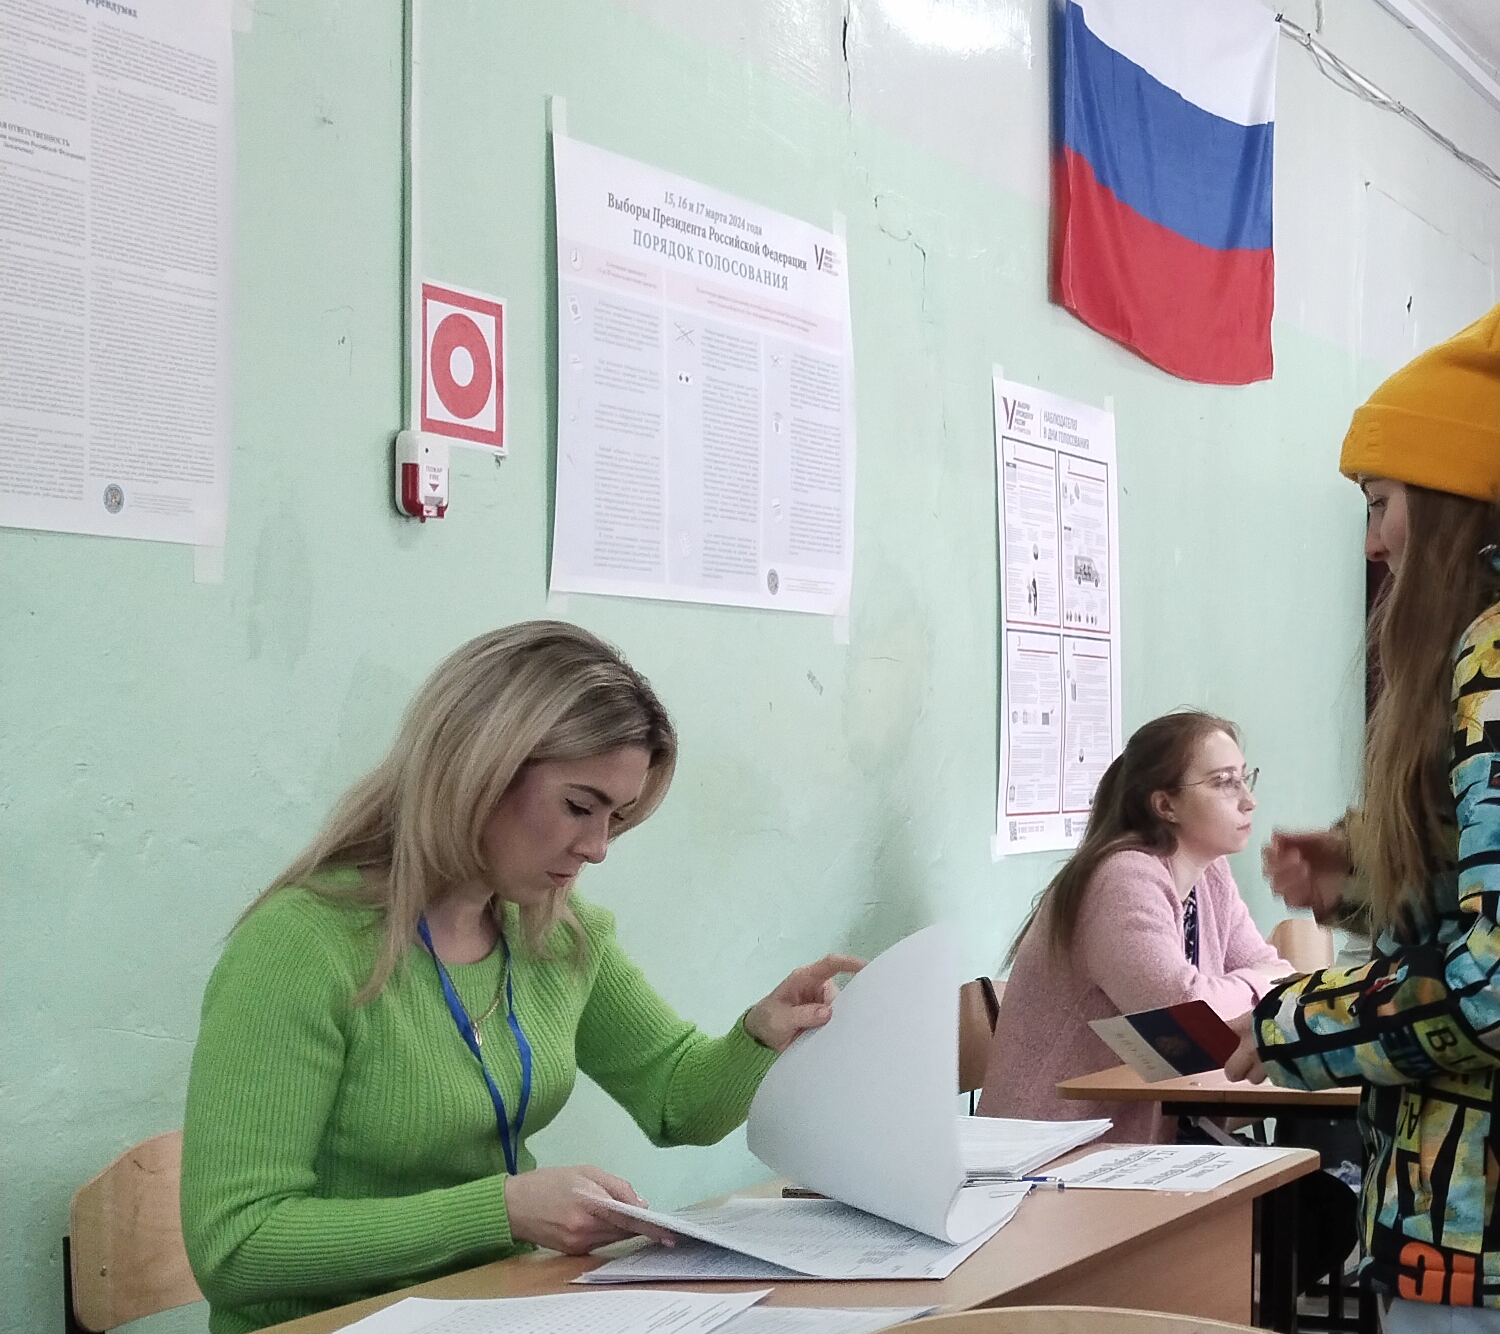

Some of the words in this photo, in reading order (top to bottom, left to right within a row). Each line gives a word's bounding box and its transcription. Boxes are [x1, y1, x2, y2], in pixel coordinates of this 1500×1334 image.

[607, 192, 650, 221] Выборы
[652, 207, 707, 239] Президента
[708, 225, 761, 256] Российской
[762, 244, 808, 271] Федерации
[664, 191, 676, 207] 15,
[677, 196, 688, 210] 16
[688, 202, 695, 213] и
[695, 202, 705, 215] 17
[705, 208, 727, 225] марта
[728, 213, 746, 231] 2024
[746, 222, 763, 236] года
[632, 228, 695, 263] ПОРЯДОК
[697, 249, 789, 292] ГОЛОСОВАНИЯ
[1043, 410, 1078, 431] НАБЛЮДАТЕЛЮ
